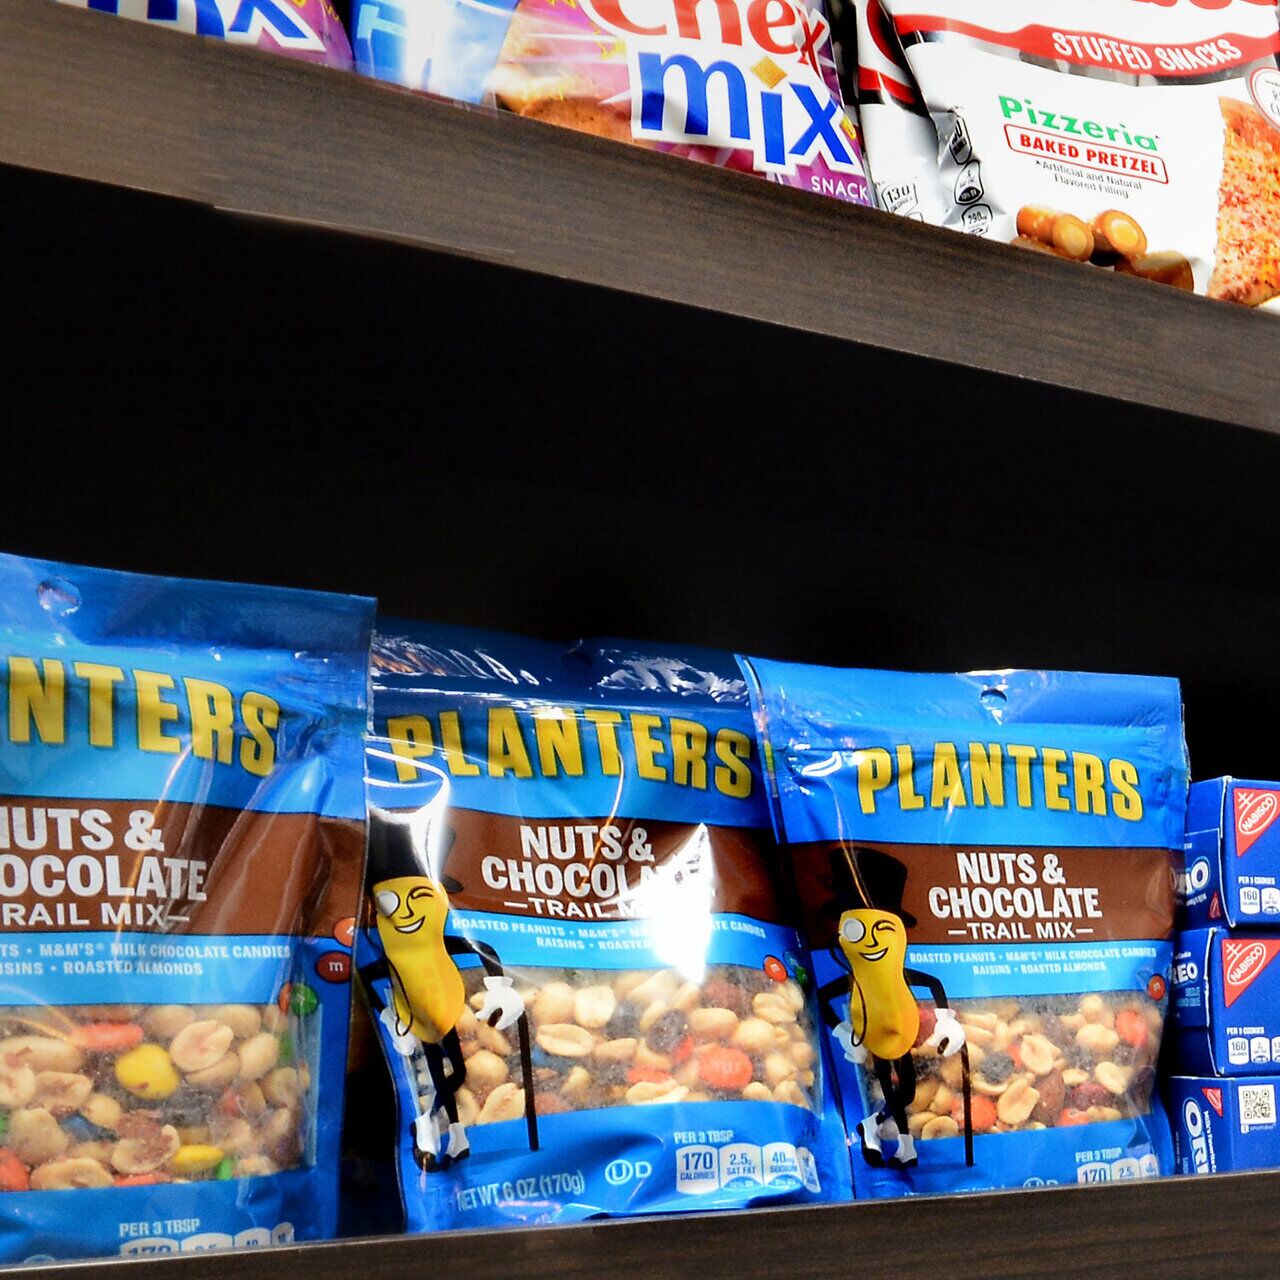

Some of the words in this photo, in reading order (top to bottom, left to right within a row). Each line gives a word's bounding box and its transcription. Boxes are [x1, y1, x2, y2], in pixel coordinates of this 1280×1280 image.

[1052, 32, 1152, 71] STUFFED
[1156, 35, 1242, 72] SNACKS
[638, 52, 853, 166] mix
[998, 95, 1157, 152] Pizzeria
[1020, 133, 1079, 159] BAKED
[1087, 150, 1158, 176] PRETZEL
[810, 176, 868, 200] SNACK
[7, 655, 281, 777] NTERS
[386, 707, 752, 799] PLANTERS
[854, 741, 1143, 821] PLANTERS
[1242, 796, 1273, 831] NABISCO
[521, 825, 622, 862] NUTS
[628, 827, 655, 862] &
[956, 852, 1037, 885] NUTS
[1042, 853, 1065, 885] &
[102, 903, 168, 926] MIX
[529, 898, 604, 919] TRAIL
[928, 886, 1102, 920] CHOCOLATE
[512, 922, 564, 936] PEANUTS
[967, 922, 1032, 941] TRAIL
[1036, 922, 1077, 940] MIX
[150, 945, 229, 959] CHOCOLATE
[233, 946, 291, 959] CANDIES
[910, 950, 951, 964] ROASTED
[953, 950, 996, 963] PEANUTS
[1044, 949, 1066, 960] MILK
[1069, 948, 1119, 961] CHOCOLATE
[1230, 945, 1263, 981] NABISCO
[63, 961, 133, 975] ROASTED
[136, 962, 203, 975] ALMONDS
[972, 963, 1011, 975] RAISINS
[1020, 962, 1060, 974] ROASTED
[1062, 961, 1106, 973] ALMONDS
[674, 1131, 695, 1143] PER
[707, 1130, 734, 1142] TBSP
[682, 1152, 714, 1170] 170
[120, 1222, 148, 1237] PER
[164, 1218, 200, 1232] TBSP
